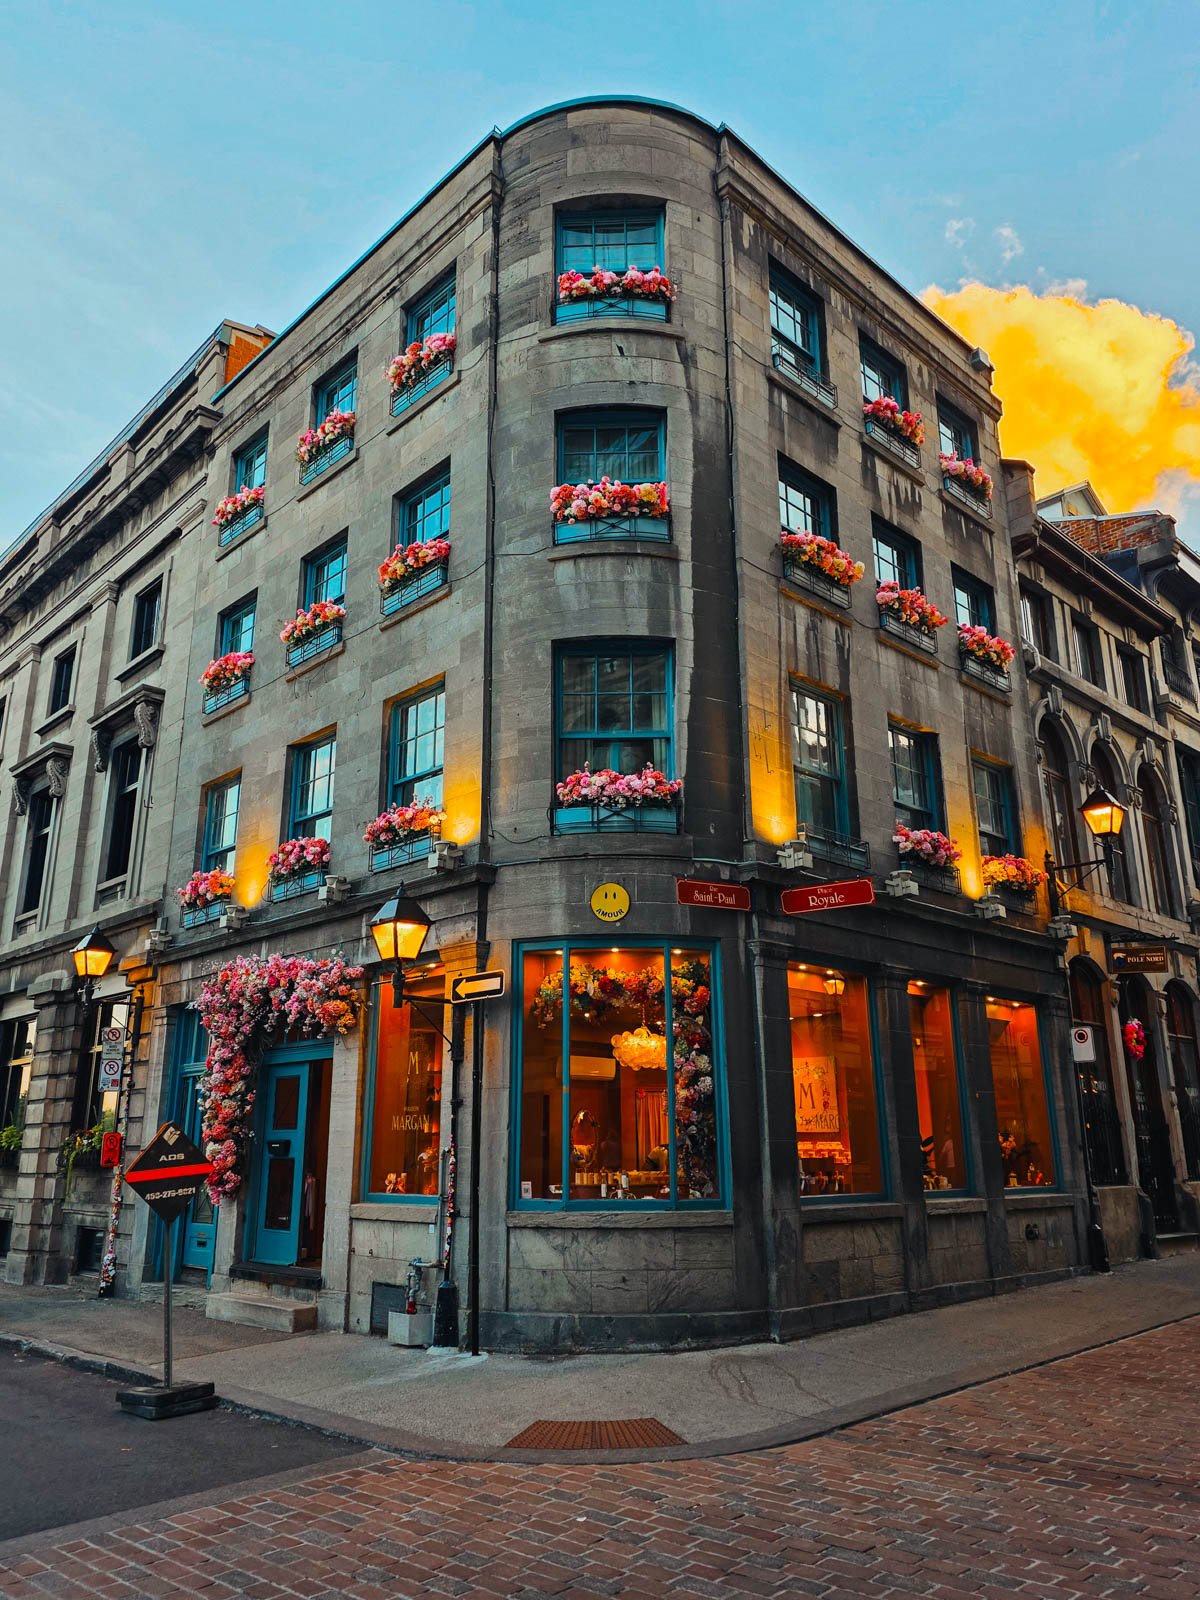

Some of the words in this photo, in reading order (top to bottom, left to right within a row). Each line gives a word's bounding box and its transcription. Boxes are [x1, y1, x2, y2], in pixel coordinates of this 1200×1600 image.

[693, 890, 736, 905] Saint-Paul
[808, 892, 845, 908] Royale
[596, 908, 625, 918] AMOUR
[408, 1051, 419, 1075] M
[391, 1114, 430, 1131] MARGAN
[159, 1153, 185, 1162] ADS
